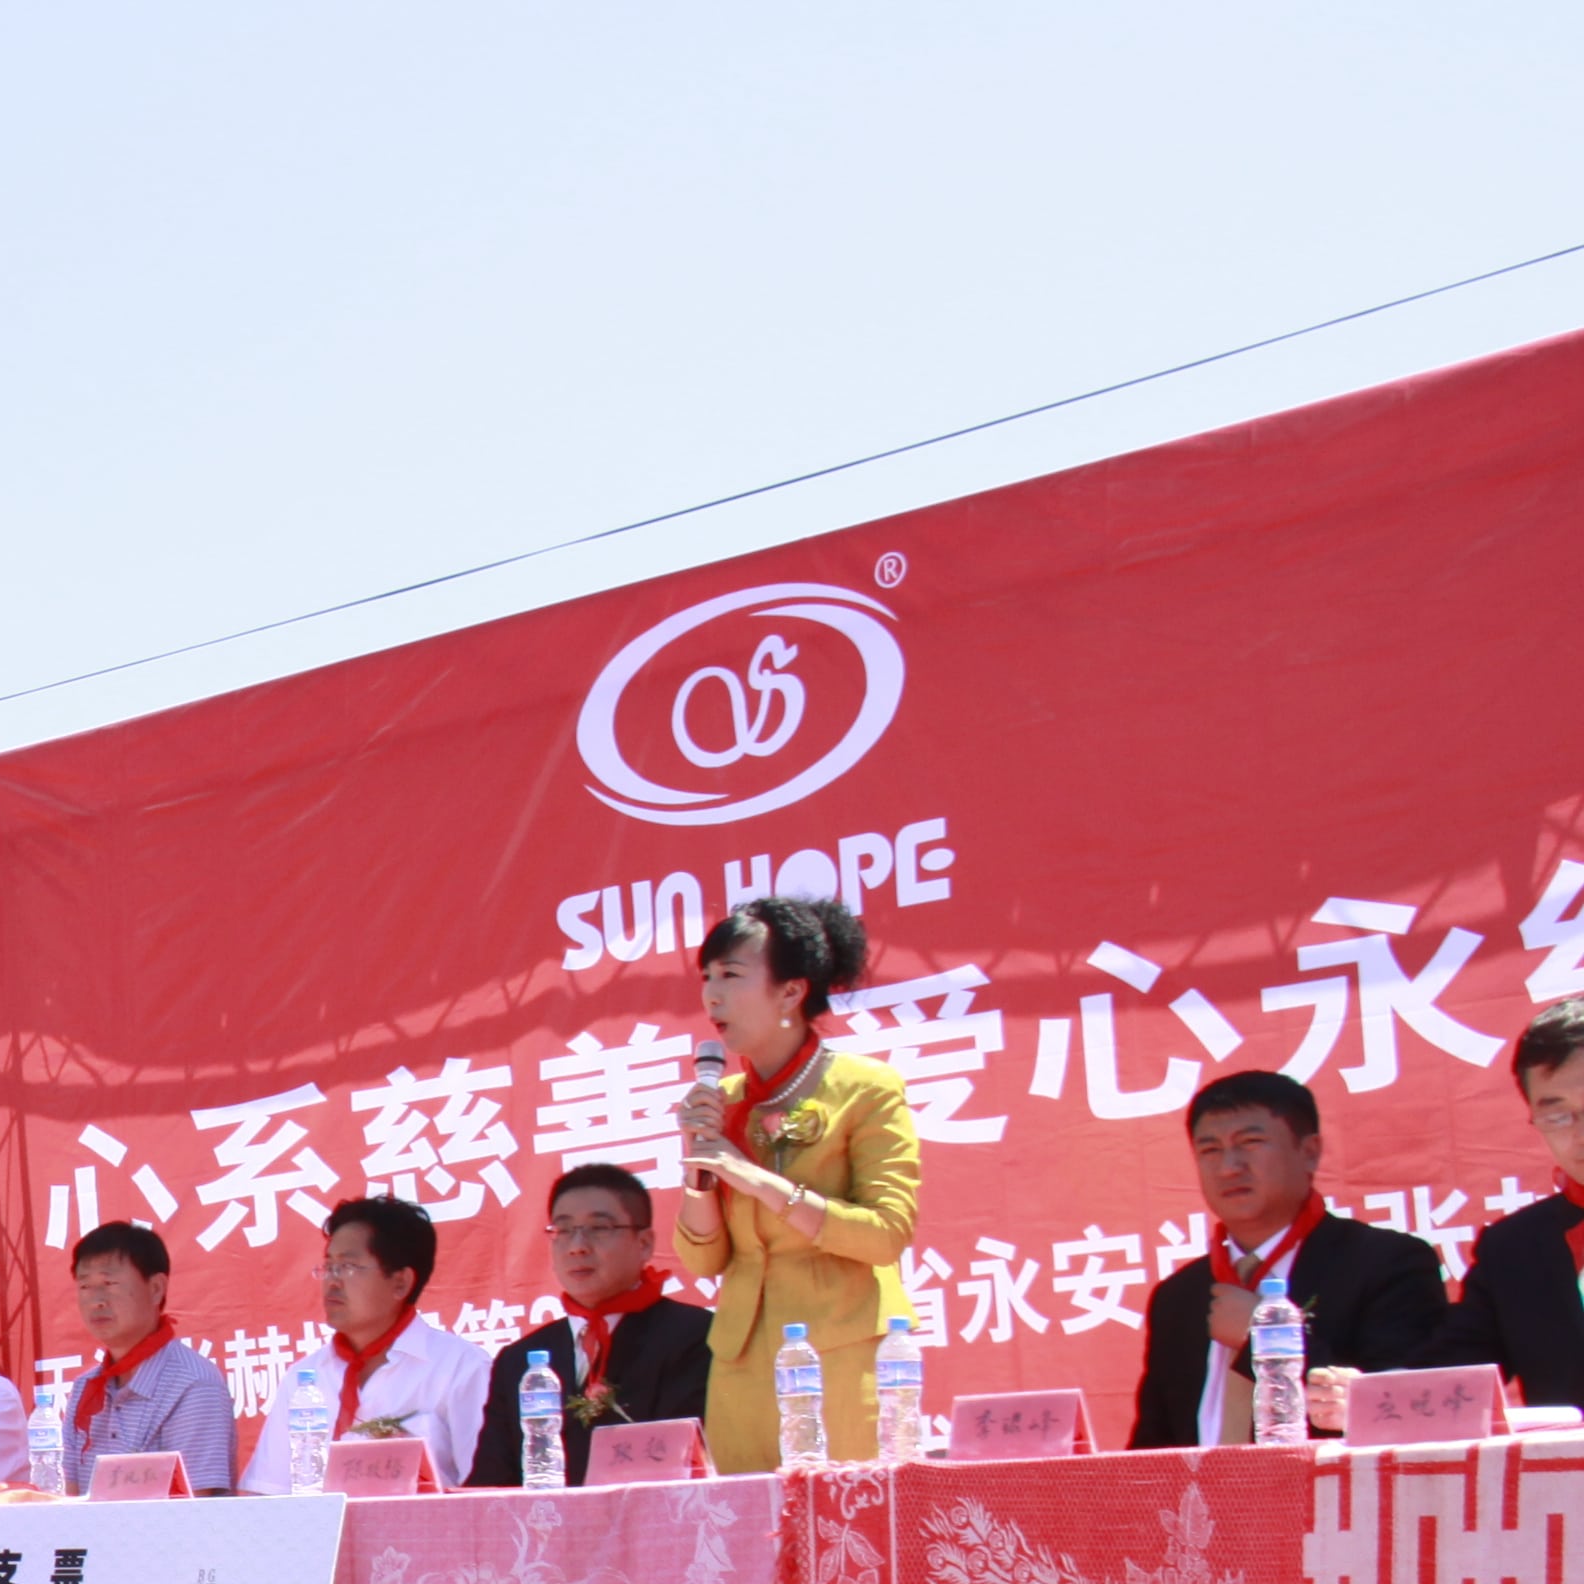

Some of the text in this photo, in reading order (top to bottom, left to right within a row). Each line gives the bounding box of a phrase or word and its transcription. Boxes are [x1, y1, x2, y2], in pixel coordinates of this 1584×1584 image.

[555, 816, 956, 971] SUN HOPE
[44, 1022, 694, 1253] 心系慈善
